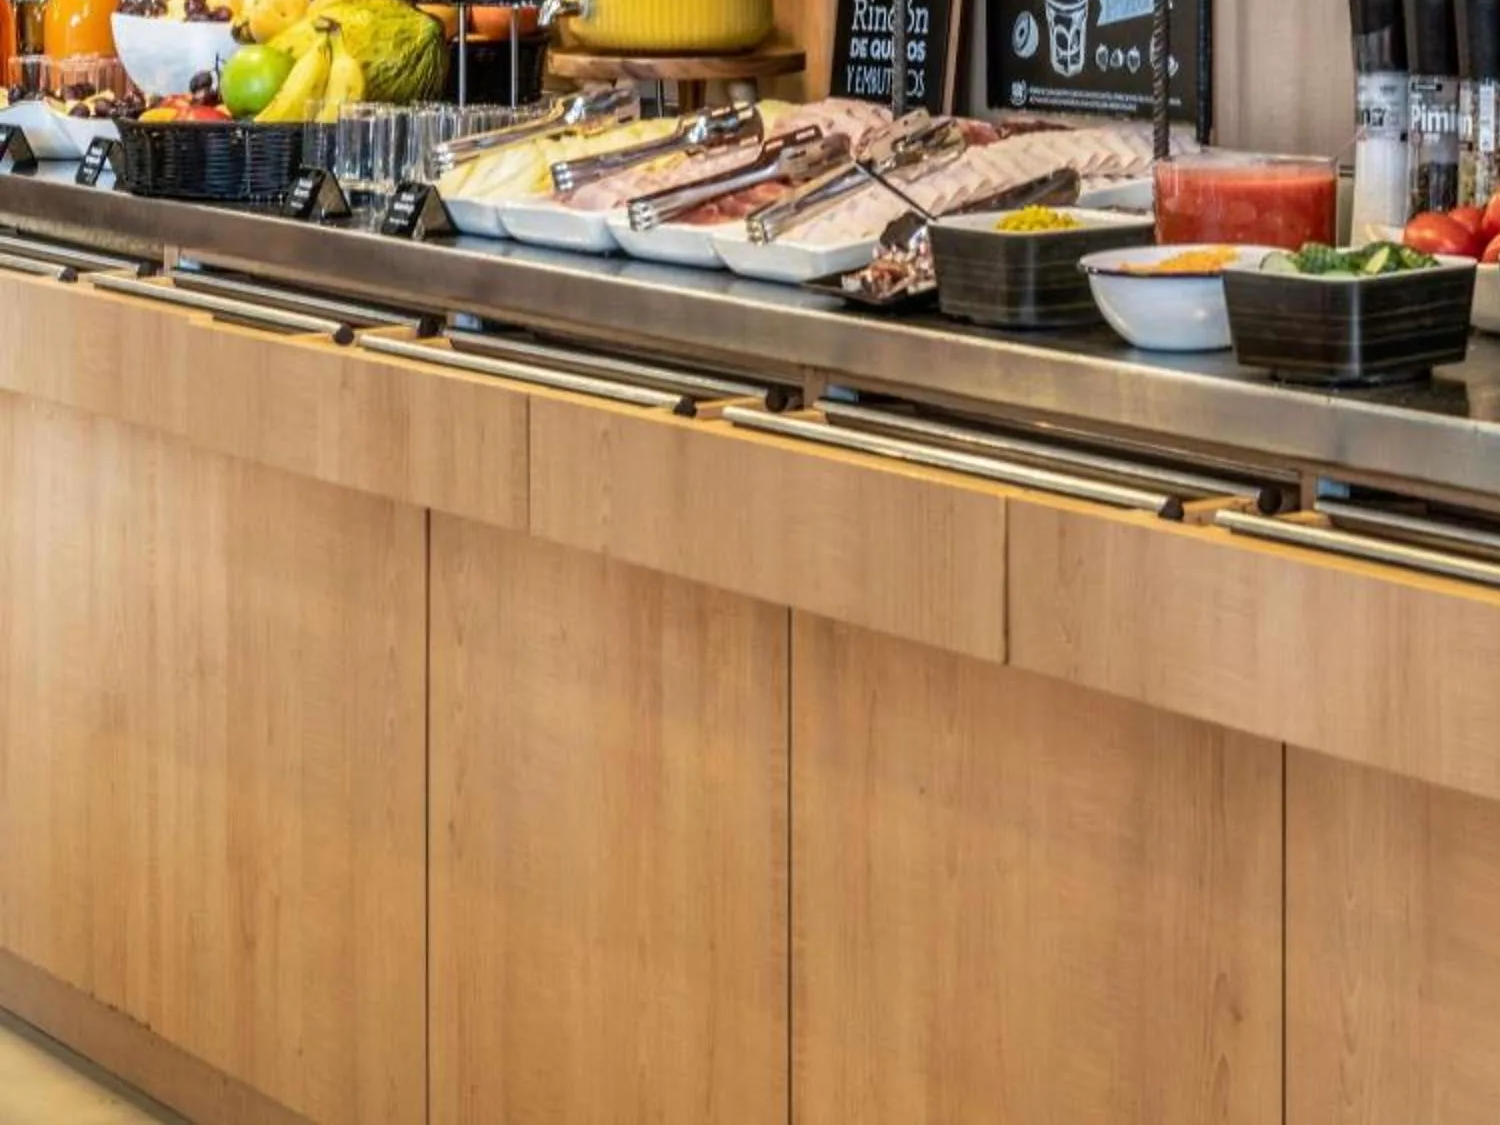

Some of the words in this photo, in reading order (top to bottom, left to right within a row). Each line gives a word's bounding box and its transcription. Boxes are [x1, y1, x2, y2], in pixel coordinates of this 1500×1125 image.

[849, 37, 869, 59] DE
[869, 38, 927, 63] QUOS
[855, 65, 926, 98] EMBUTOS
